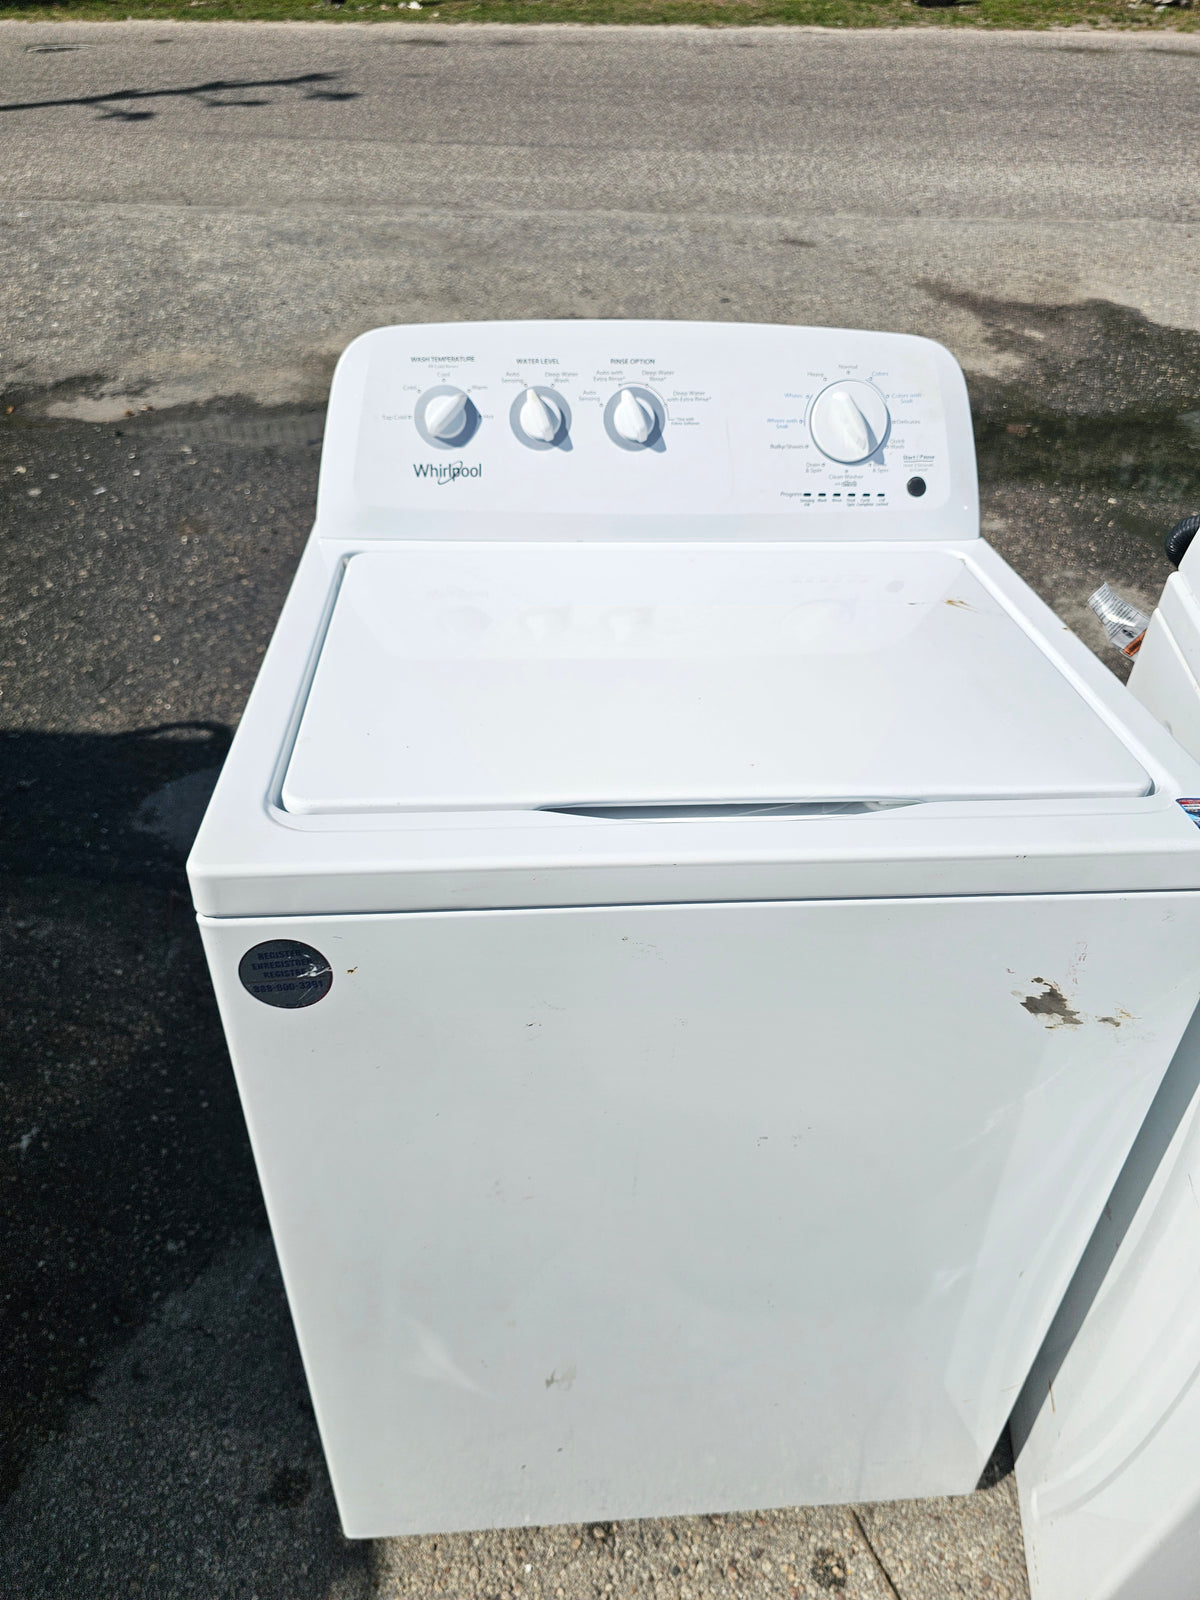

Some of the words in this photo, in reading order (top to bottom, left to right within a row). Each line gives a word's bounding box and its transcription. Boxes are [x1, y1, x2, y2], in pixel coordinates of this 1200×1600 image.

[413, 461, 482, 485] Whirlpool
[258, 949, 301, 960] REGISTER
[252, 958, 313, 970] ENREGISTRER
